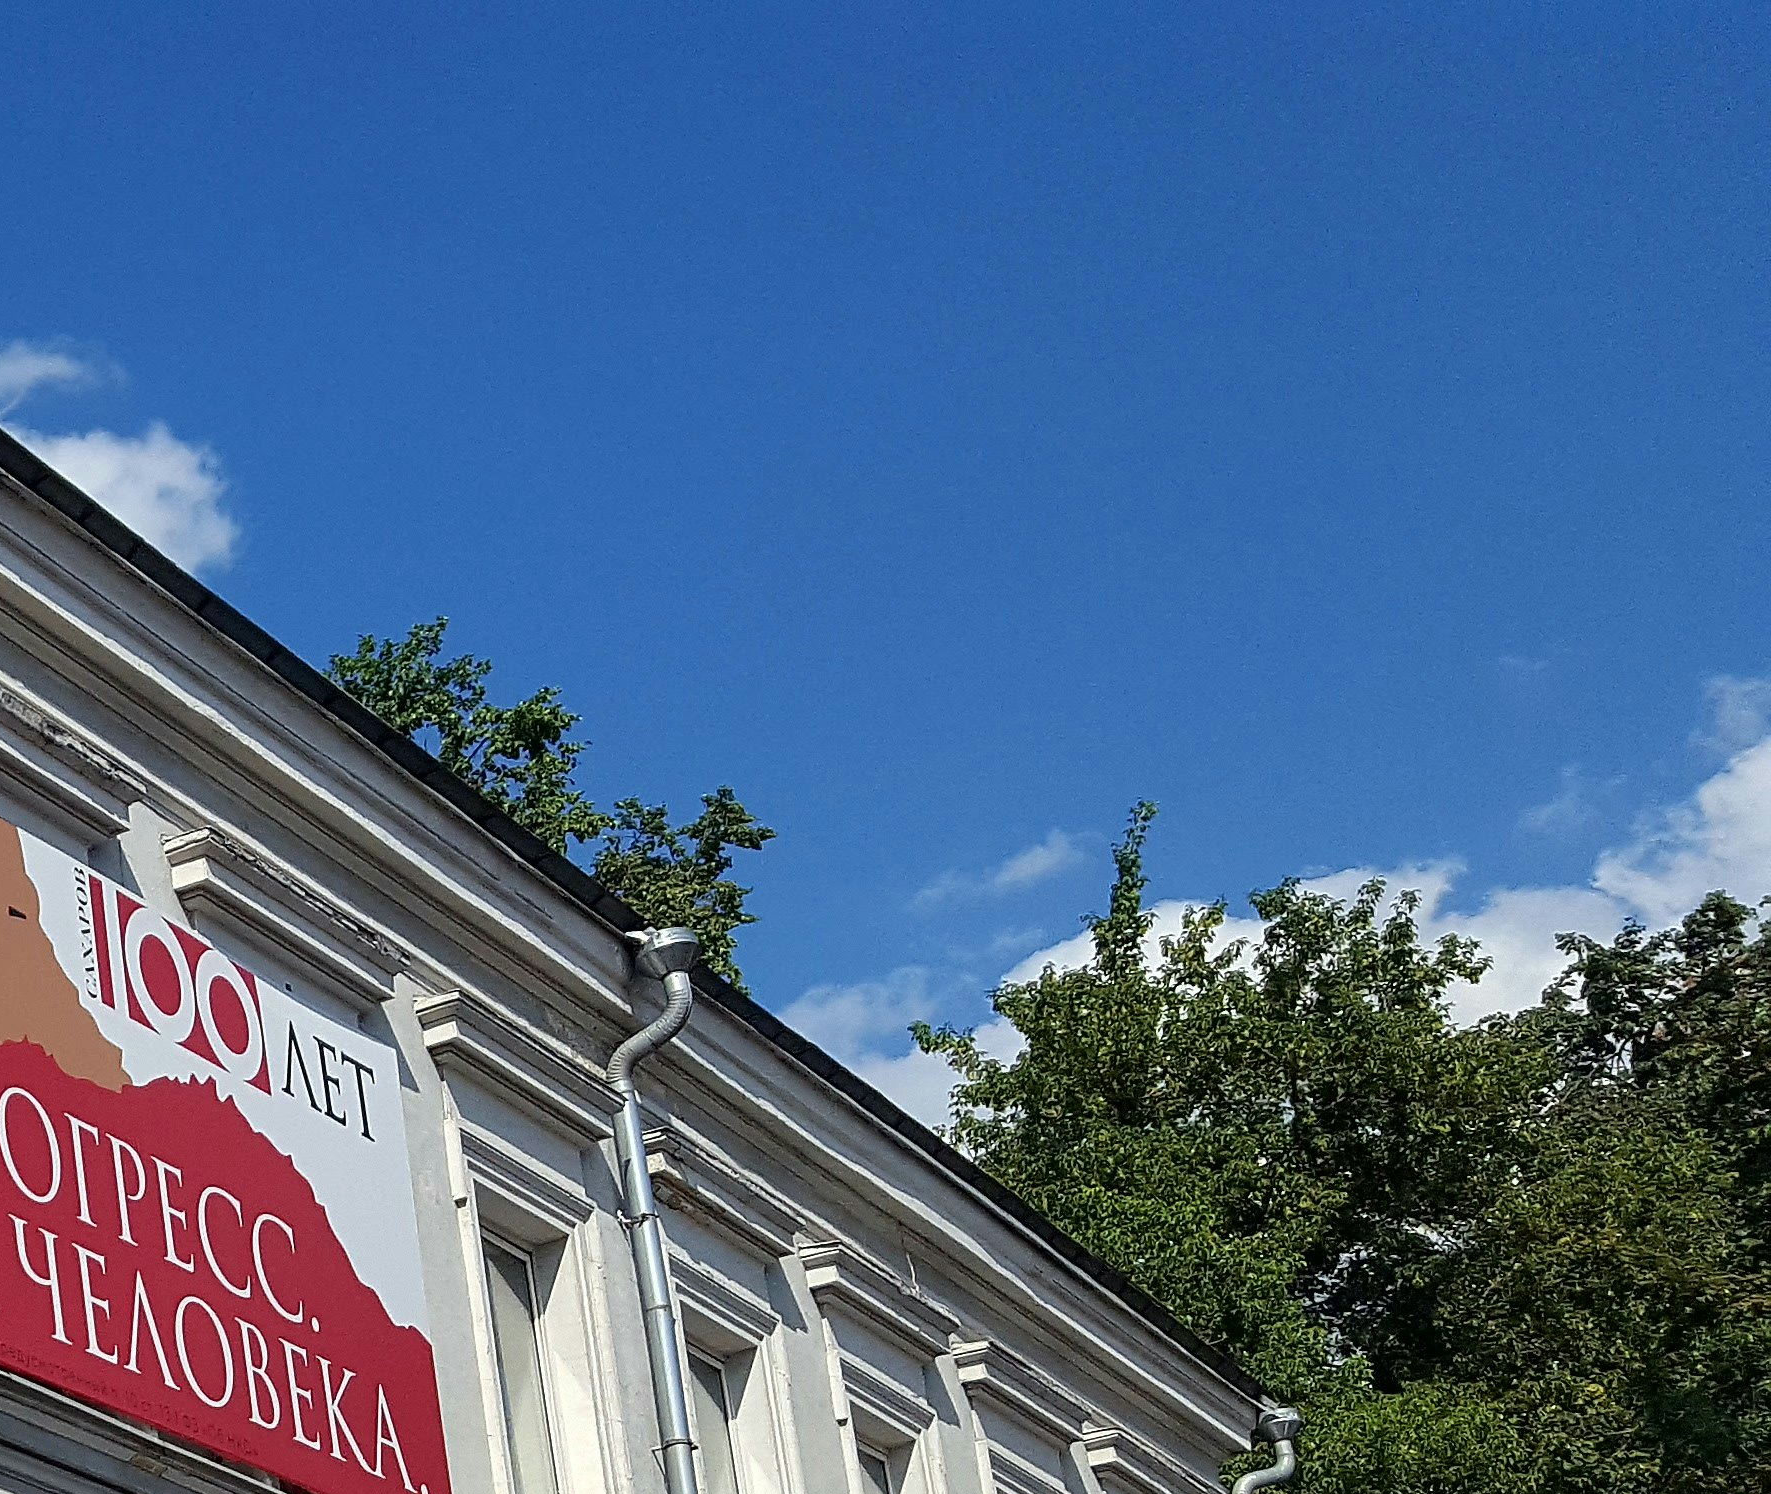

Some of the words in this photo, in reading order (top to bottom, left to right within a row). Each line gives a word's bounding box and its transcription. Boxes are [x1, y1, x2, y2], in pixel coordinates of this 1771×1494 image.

[73, 866, 99, 999] САХАРОВ
[99, 876, 267, 1090] 100
[281, 1020, 376, 1143] ЛЕТ
